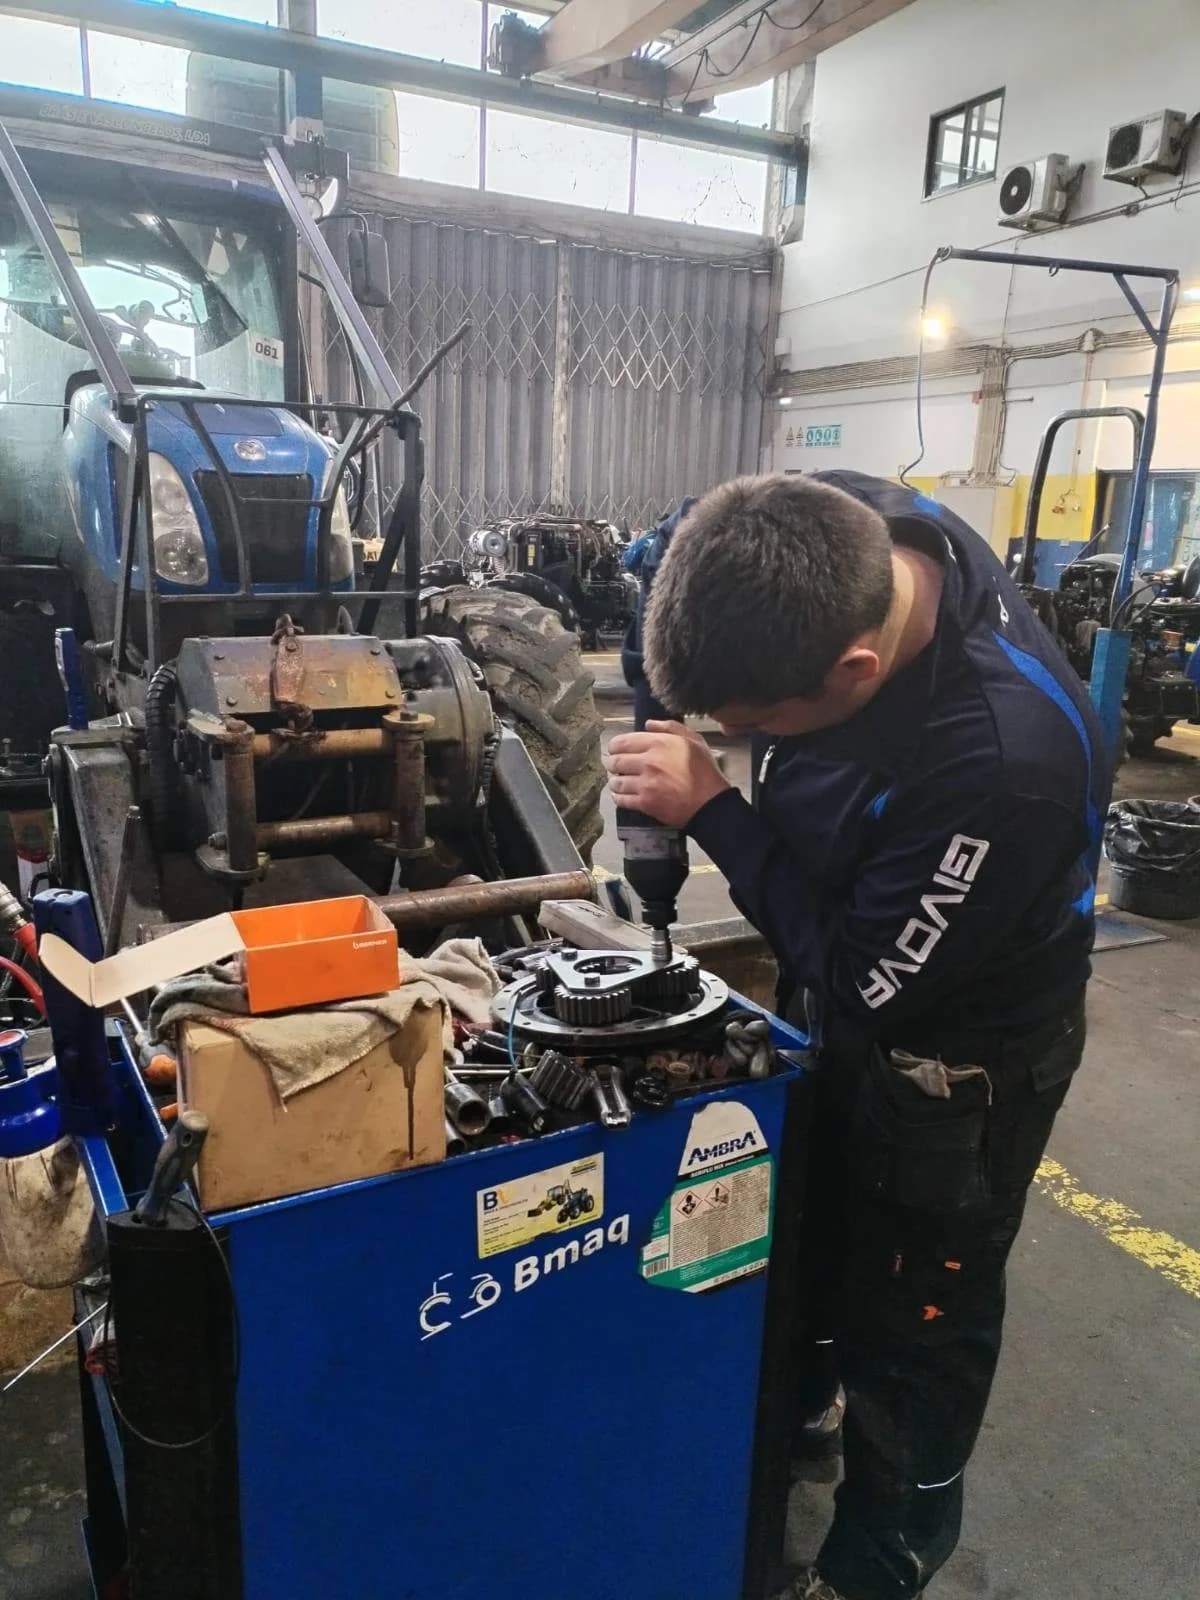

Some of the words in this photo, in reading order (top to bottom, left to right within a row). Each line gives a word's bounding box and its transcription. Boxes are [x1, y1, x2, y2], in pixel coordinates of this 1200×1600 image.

[255, 342, 278, 360] 061
[855, 833, 990, 1009] GIVOVA
[514, 1213, 630, 1293] Bmaq
